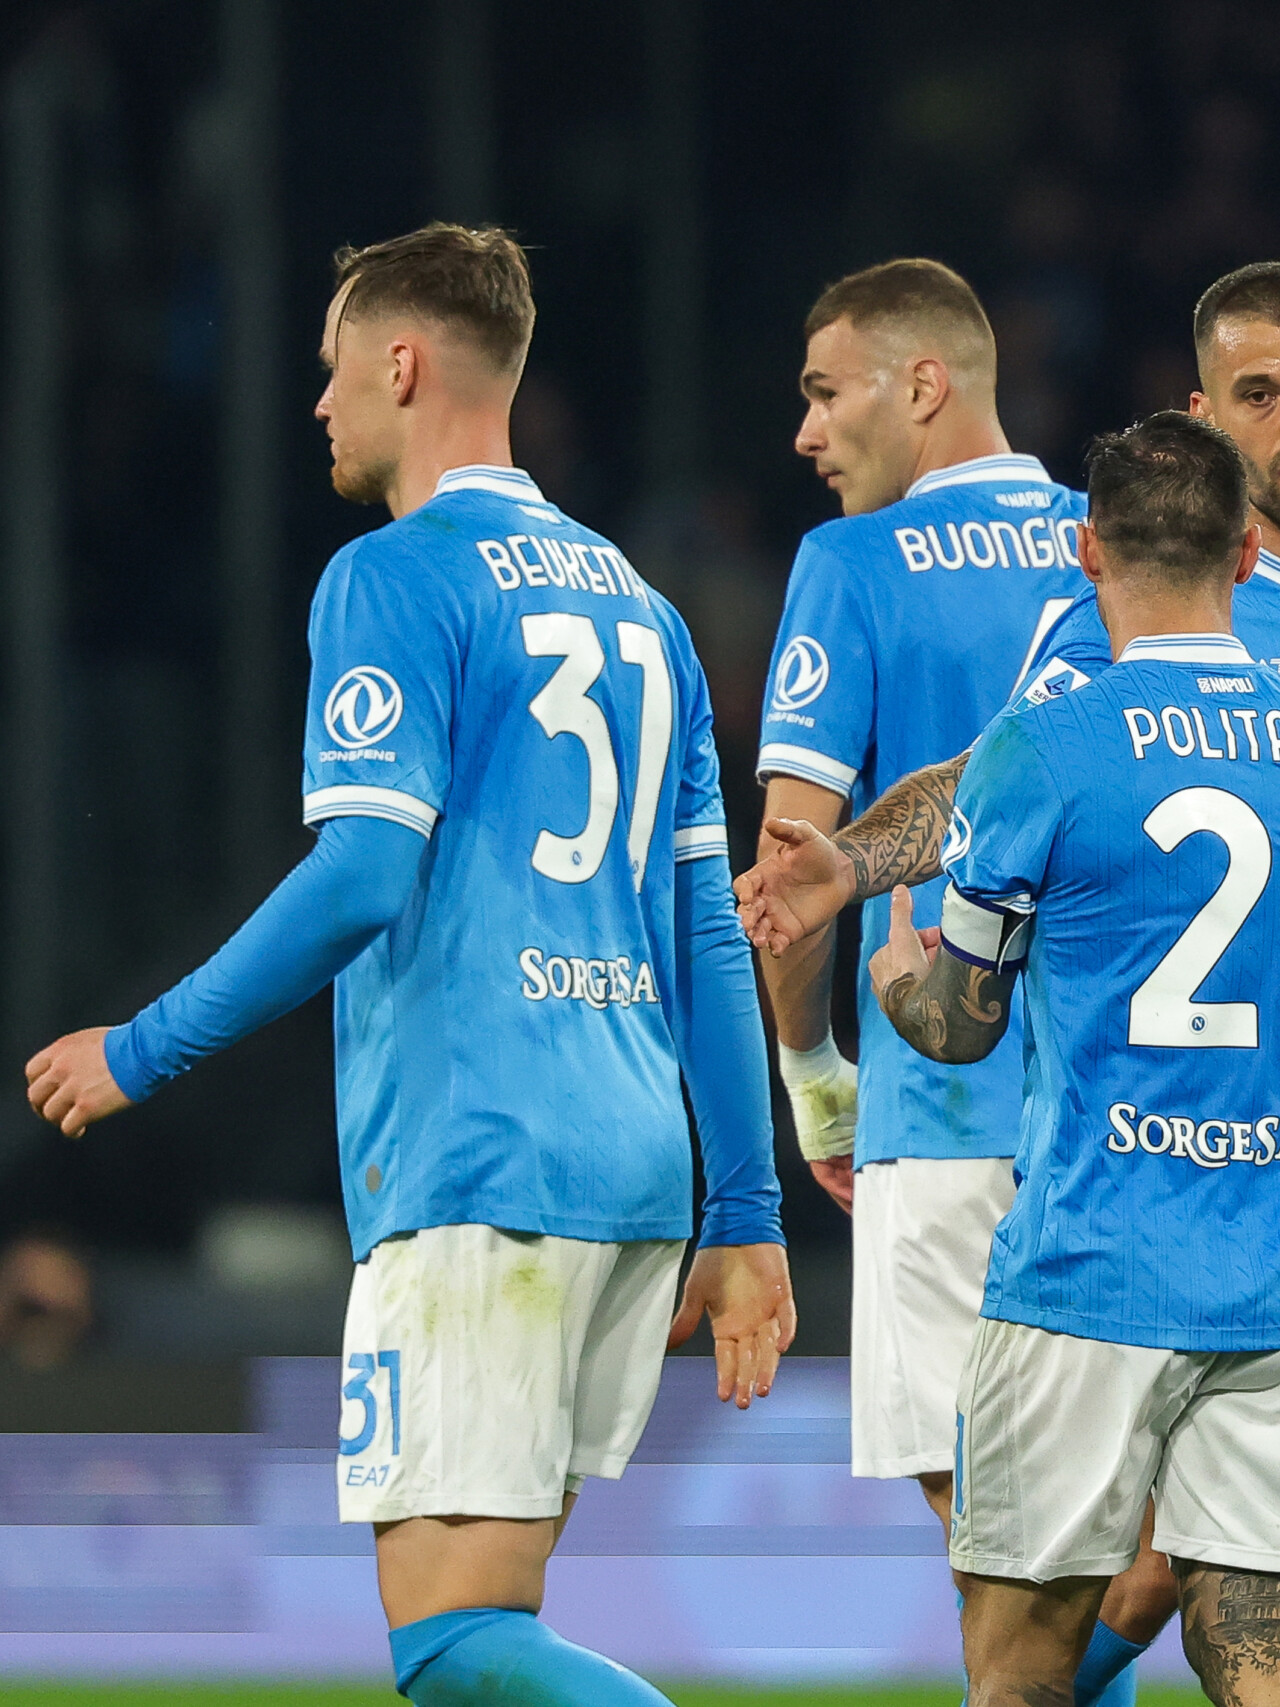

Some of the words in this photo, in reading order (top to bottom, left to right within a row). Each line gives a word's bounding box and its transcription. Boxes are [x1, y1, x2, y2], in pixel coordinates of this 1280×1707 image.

[895, 516, 1088, 572] BUONGIO
[1209, 677, 1255, 693] NAPOLI
[519, 611, 673, 894] 31
[339, 1350, 401, 1456] 31
[346, 1465, 390, 1487] EA7
